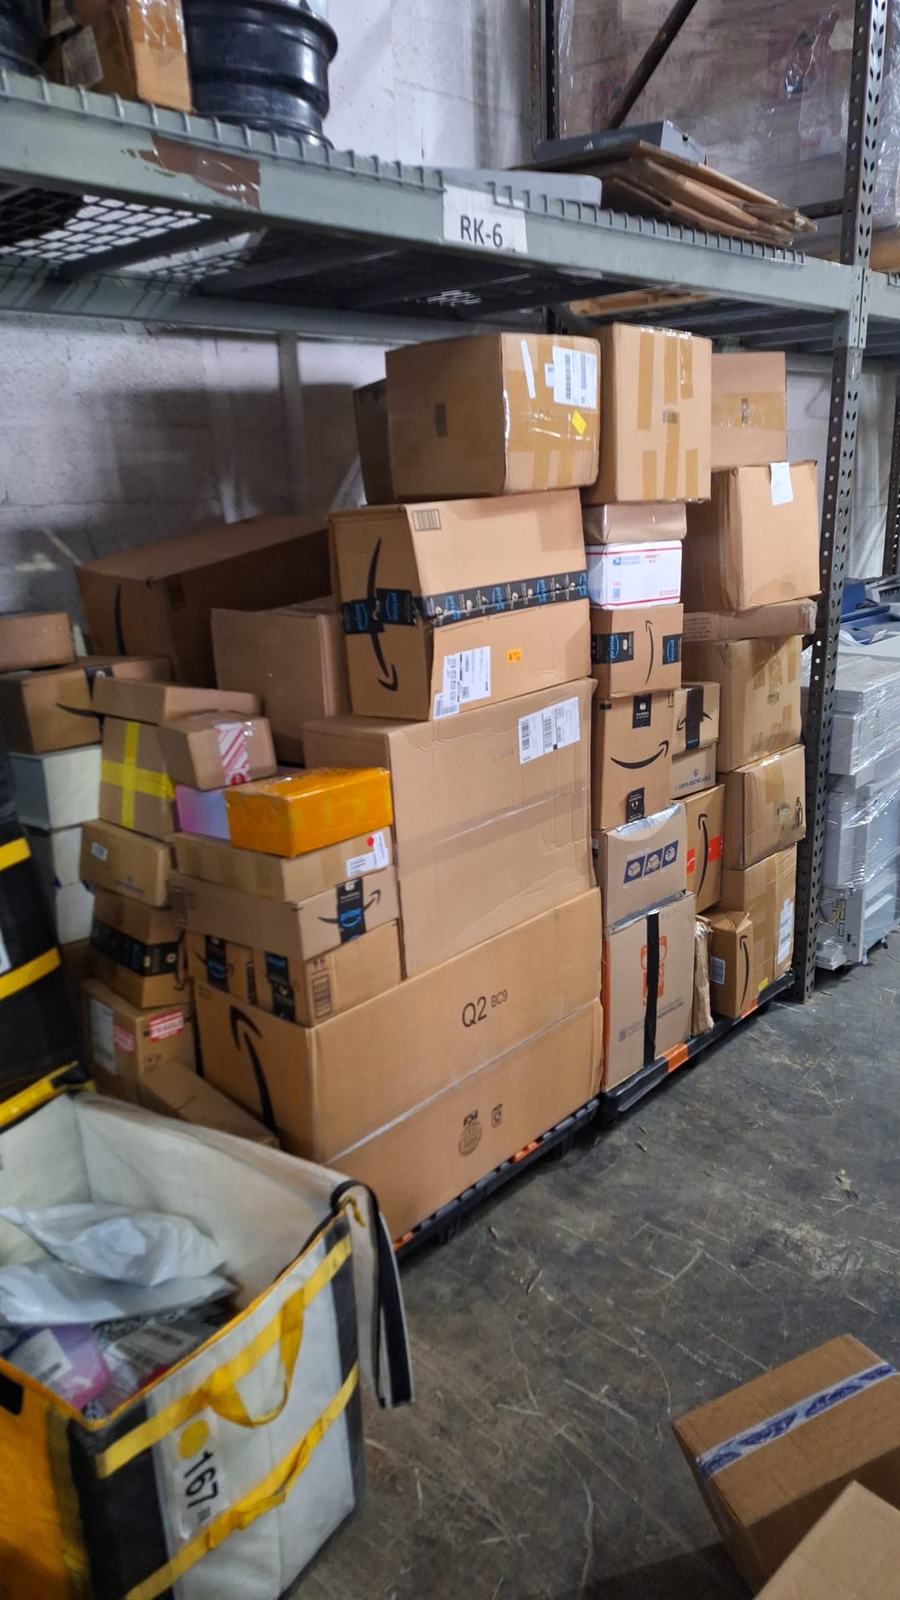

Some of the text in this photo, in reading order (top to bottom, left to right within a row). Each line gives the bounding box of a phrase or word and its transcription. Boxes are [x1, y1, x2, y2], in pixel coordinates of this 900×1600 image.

[460, 214, 503, 248] RK-6
[462, 996, 487, 1028] Q2
[183, 1450, 219, 1509] 167
